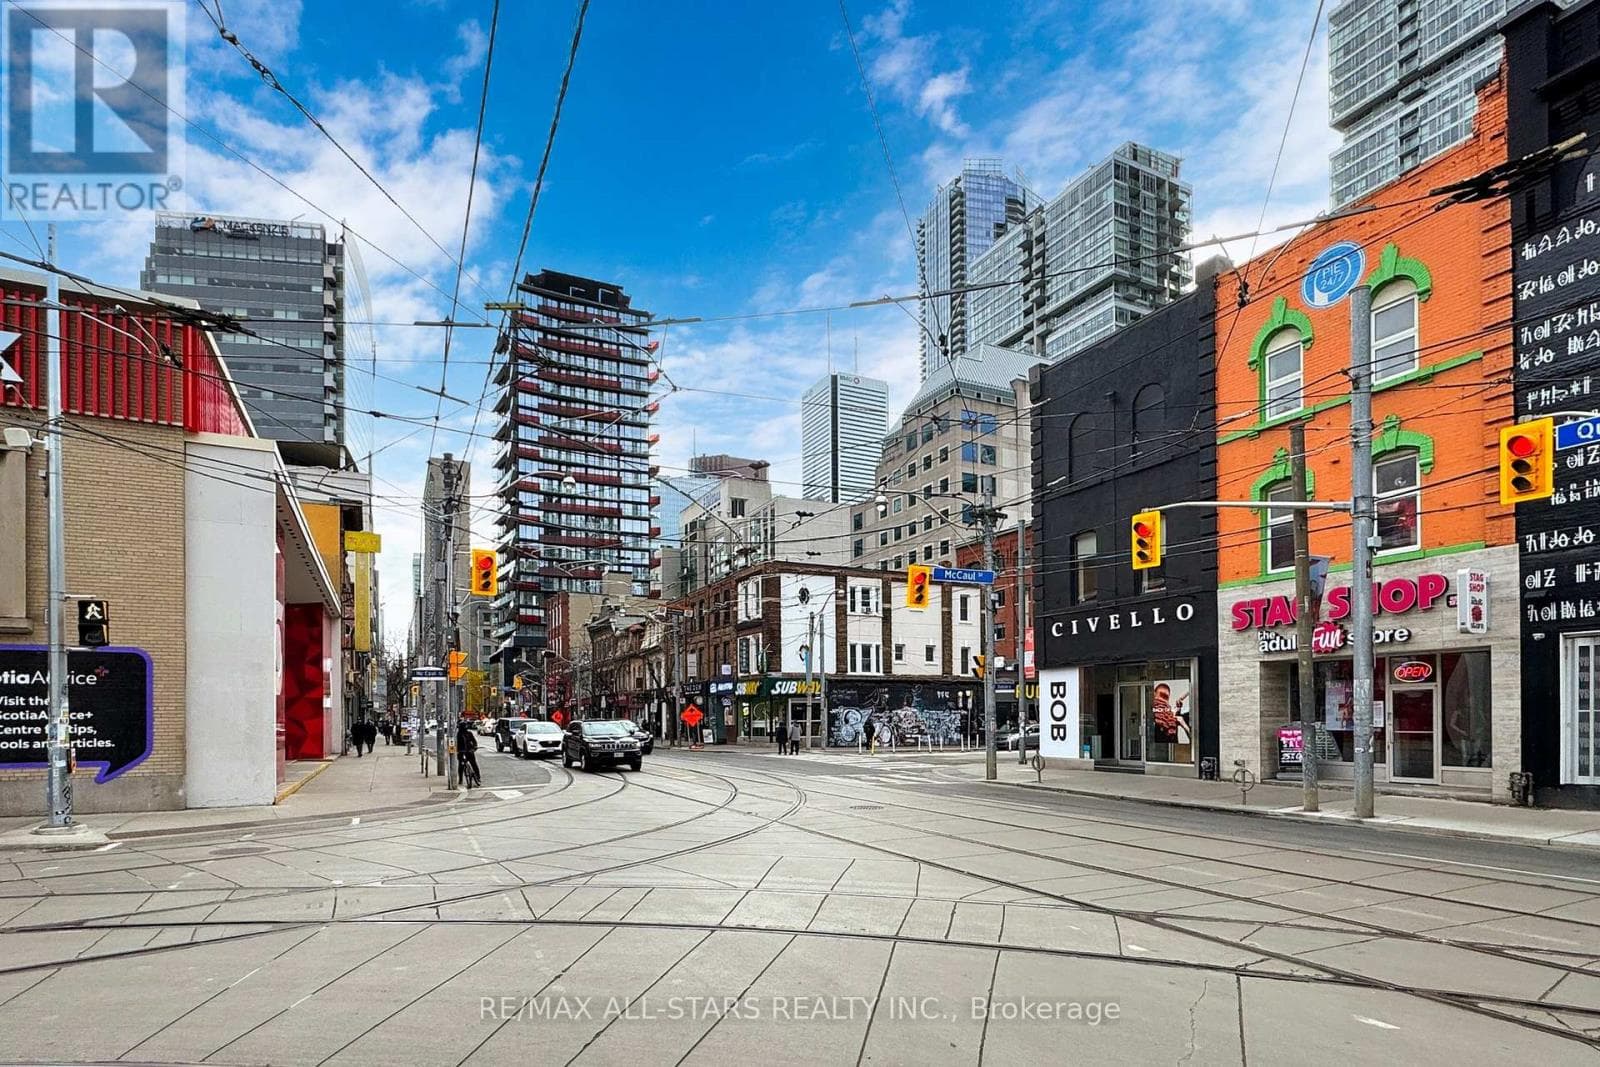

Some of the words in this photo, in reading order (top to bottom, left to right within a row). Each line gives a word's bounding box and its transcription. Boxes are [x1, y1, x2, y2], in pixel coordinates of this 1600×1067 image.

[1322, 262, 1341, 280] PIE
[1321, 272, 1344, 289] 24/7
[944, 570, 976, 581] McCaul
[1470, 572, 1484, 582] STAG
[1470, 583, 1485, 592] SHOP
[1051, 603, 1194, 637] CIVELLO
[1257, 630, 1276, 640] the
[1258, 635, 1297, 653] adul
[1347, 628, 1410, 646] sore
[1397, 666, 1429, 678] OPEN
[770, 680, 822, 696] SUBWAY
[1050, 681, 1067, 742] BOB
